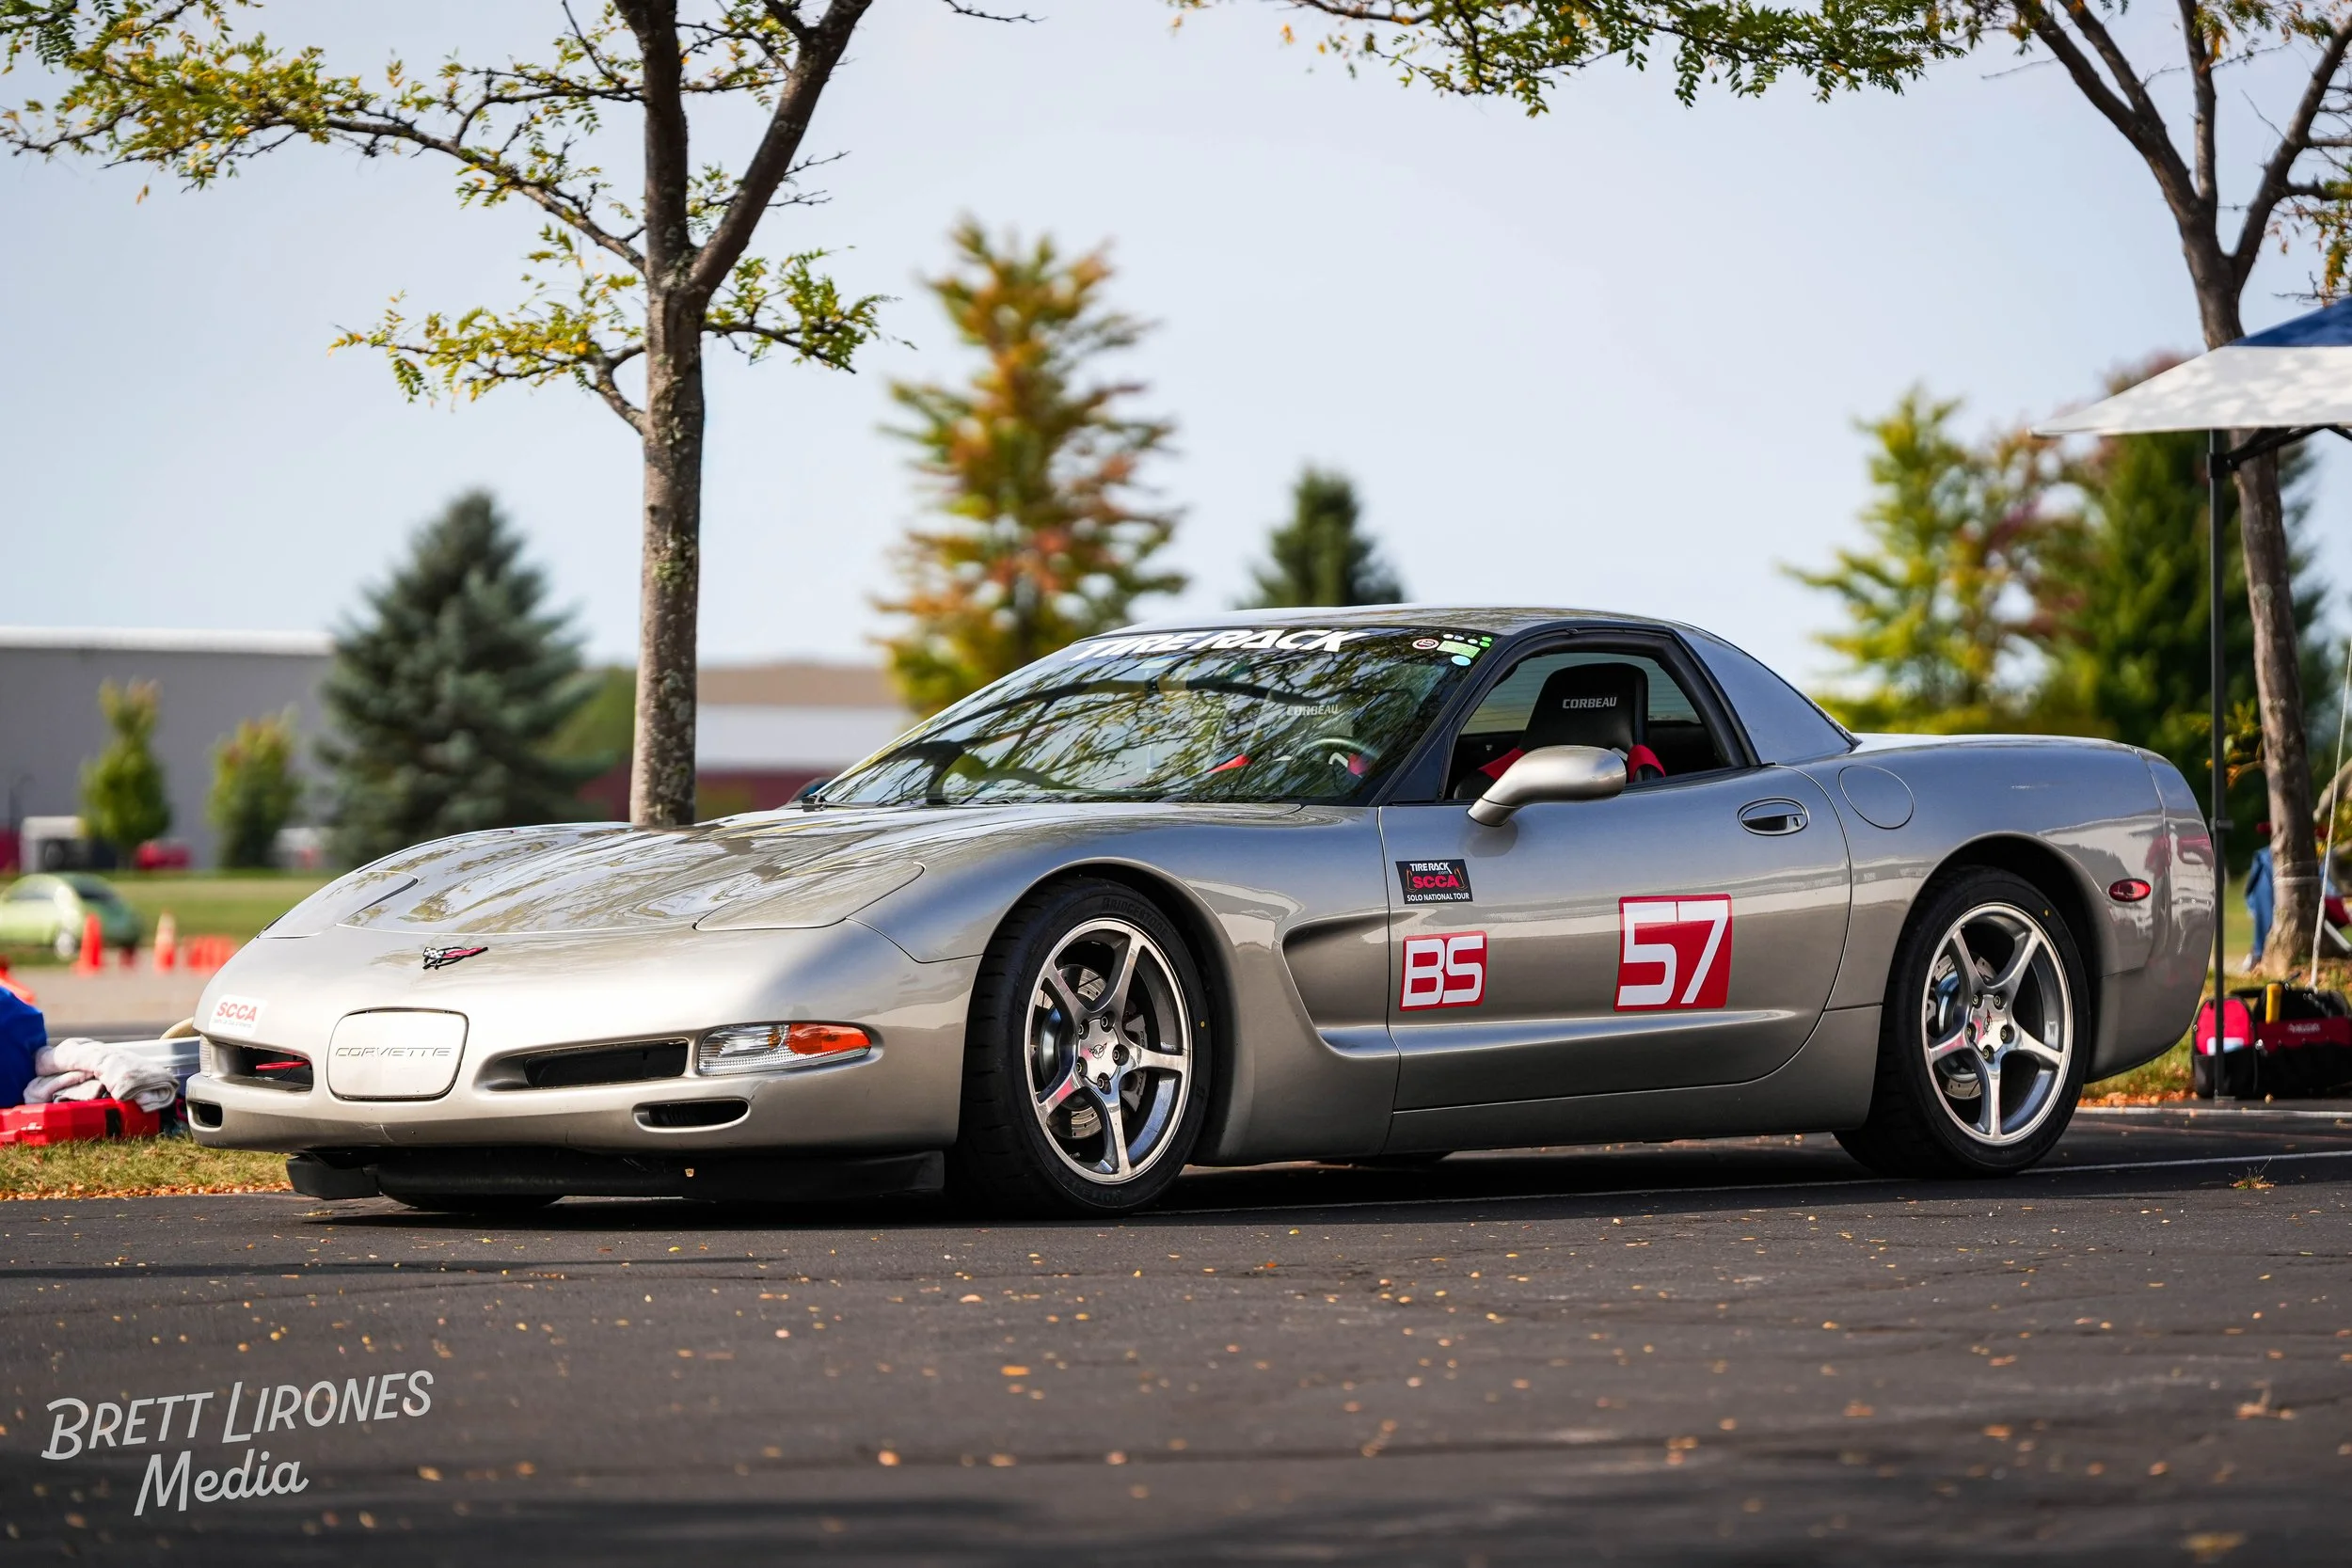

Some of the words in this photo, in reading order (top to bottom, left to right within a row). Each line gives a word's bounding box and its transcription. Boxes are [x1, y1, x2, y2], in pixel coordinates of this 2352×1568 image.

[1070, 632, 1213, 660] TIRE
[1187, 629, 1371, 652] RACK
[1563, 697, 1617, 708] CORBEAU
[1428, 863, 1453, 874] RACK
[1412, 875, 1459, 889] SCCA
[1617, 899, 1729, 1006] 57
[1402, 935, 1484, 1007] BS
[216, 1002, 257, 1022] SCCA
[336, 1047, 452, 1057] CORVETTE
